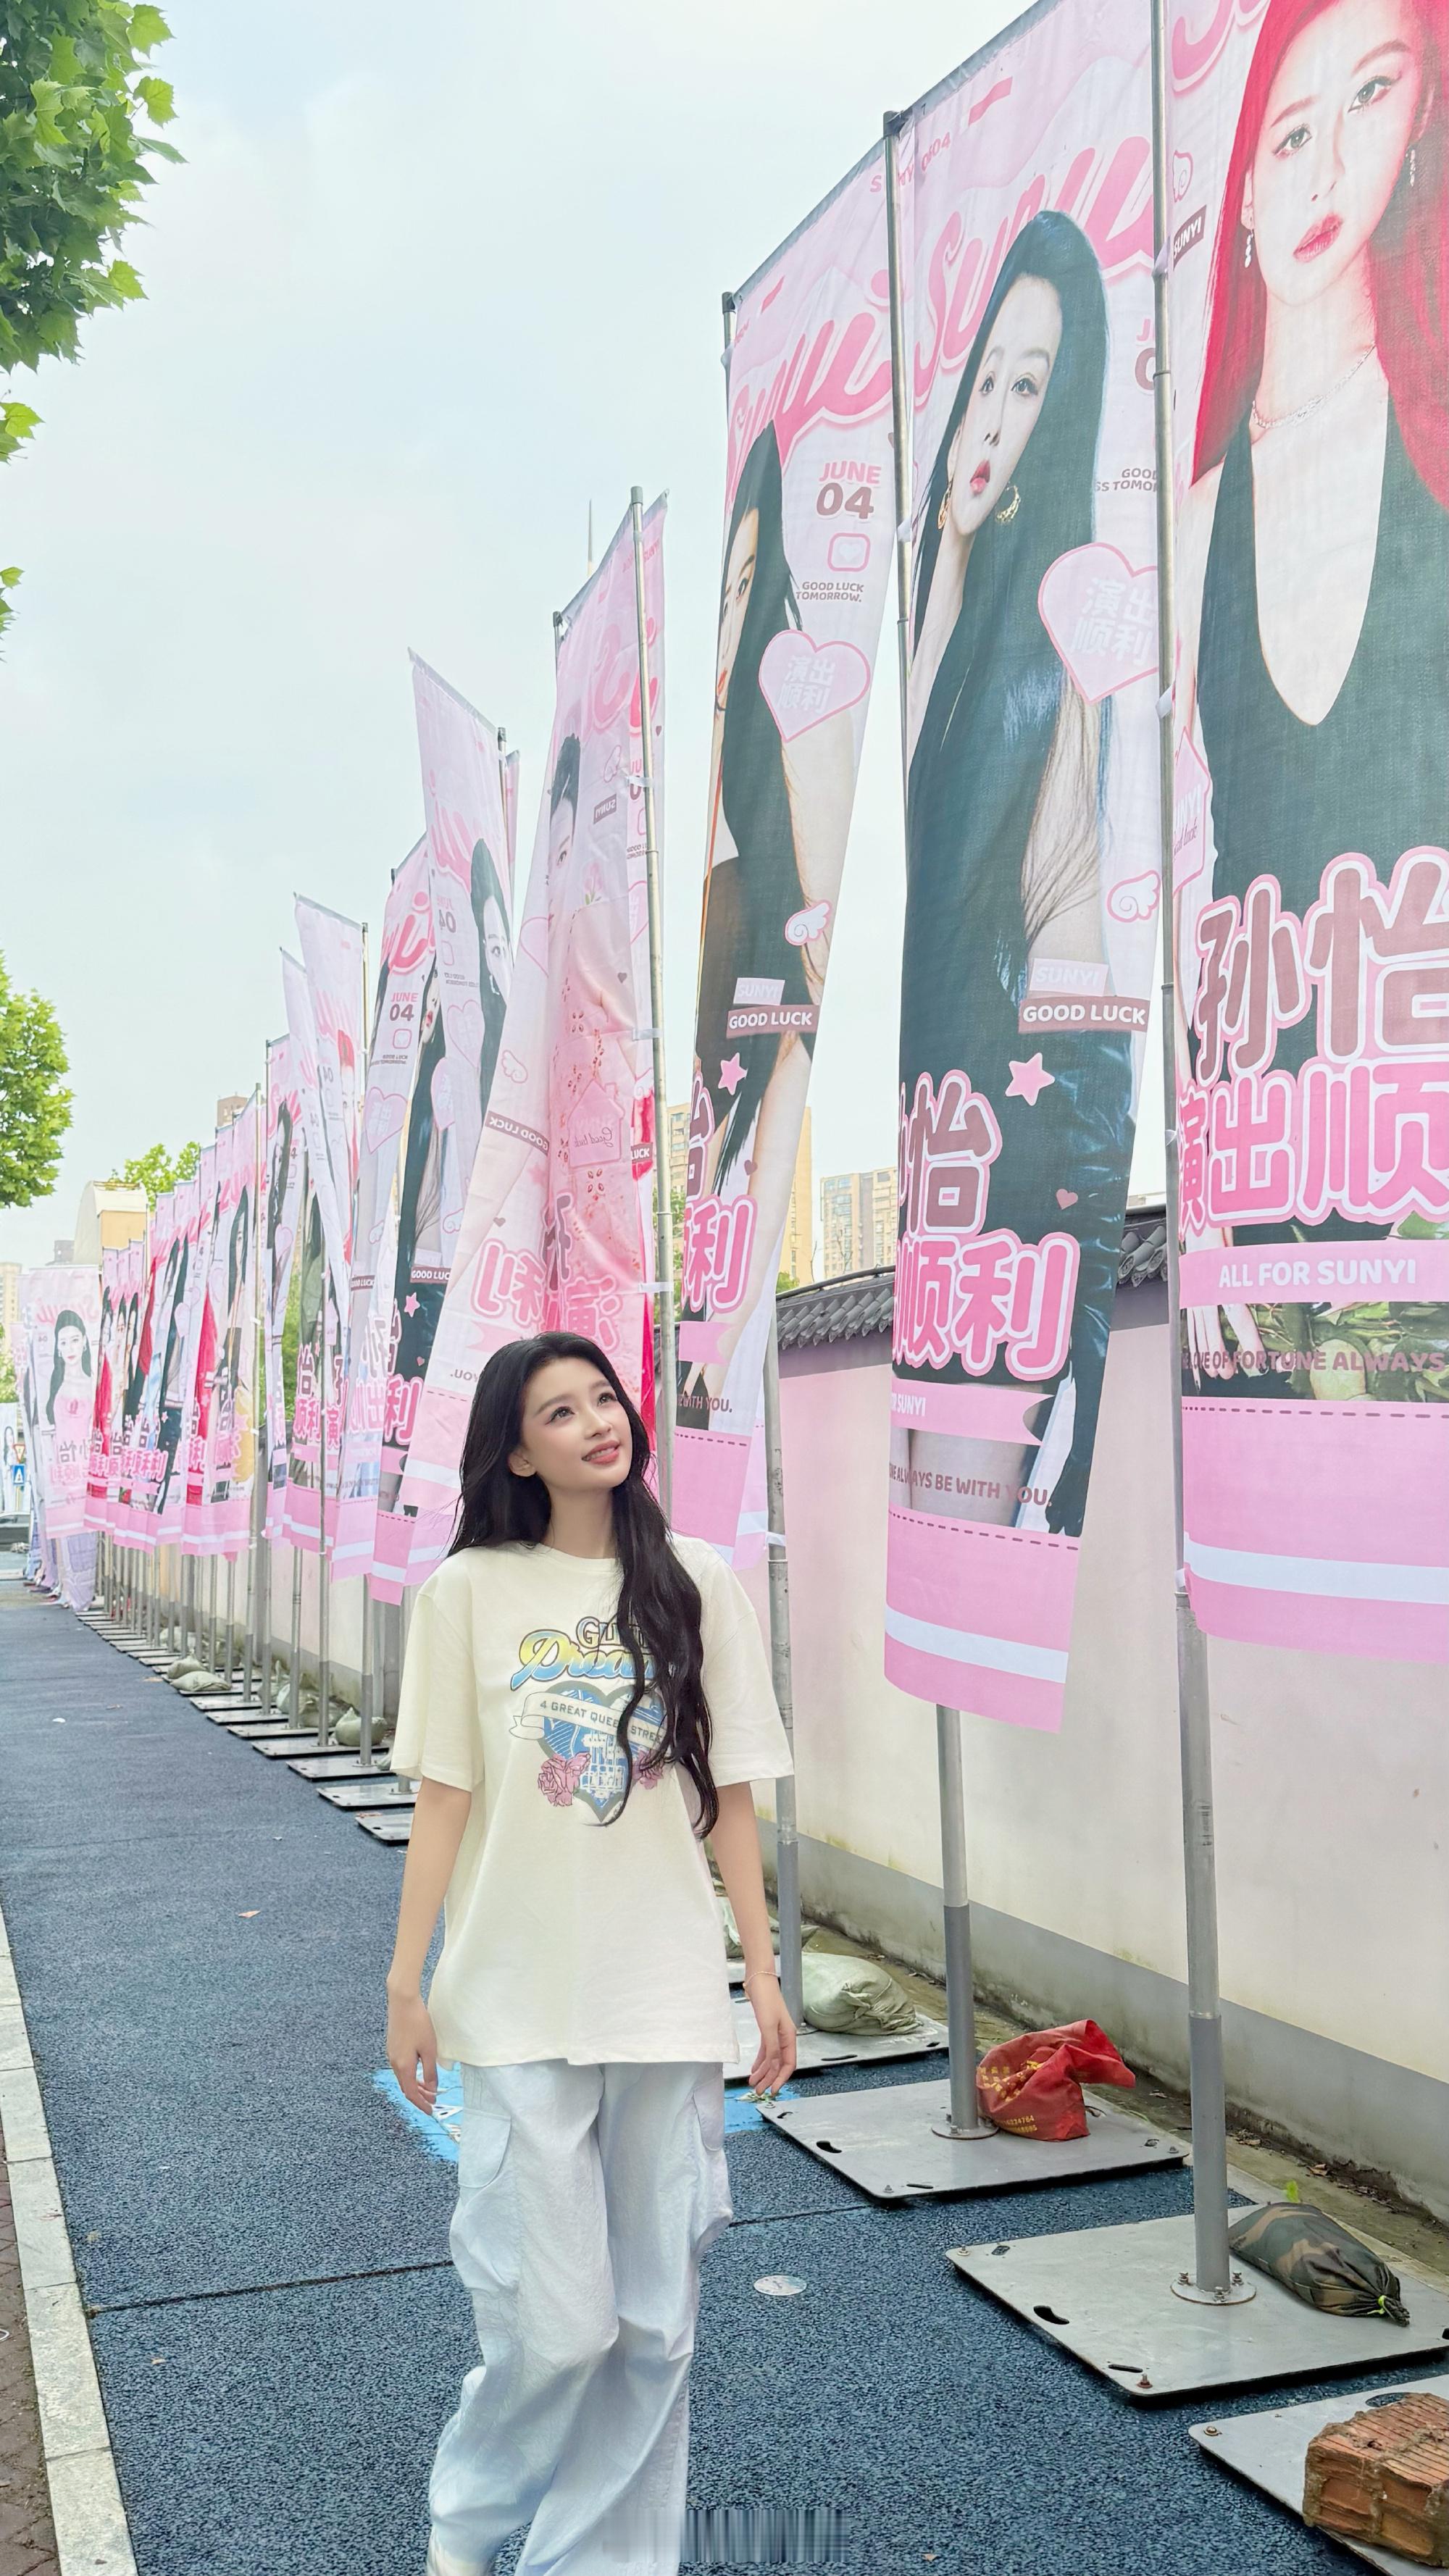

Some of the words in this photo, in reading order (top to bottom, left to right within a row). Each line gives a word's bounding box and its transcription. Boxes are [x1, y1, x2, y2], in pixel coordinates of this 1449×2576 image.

[1173, 217, 1203, 259] SUNYI
[819, 461, 881, 484] JUNE
[1114, 480, 1157, 492] TOMO
[817, 482, 874, 519] 04
[796, 591, 862, 602] TOMORROW.
[802, 582, 834, 591] GOOD
[836, 583, 864, 593] LUCK
[1083, 577, 1156, 628] 演出
[1072, 618, 1154, 665] 顺利
[778, 682, 832, 714] 顺利
[1036, 967, 1101, 986] SUNYI
[391, 993, 418, 1002] JUNE
[737, 984, 780, 999] SUNYI
[390, 1004, 414, 1021] 04
[729, 1013, 768, 1029] GOOD
[770, 1011, 813, 1026] LUCK
[1023, 1005, 1086, 1024] GOOD
[1091, 1005, 1146, 1025] LUCK
[632, 1147, 650, 1159] LUCK
[683, 1203, 750, 1305] 利
[412, 1270, 433, 1279] GOOD
[434, 1271, 451, 1281] LUC
[1218, 1264, 1253, 1288] ALL
[1258, 1261, 1310, 1286] FOR
[1316, 1258, 1416, 1285] SUNYI
[1233, 1350, 1327, 1371] FORTUNE
[1332, 1351, 1445, 1371] ALWAYS
[706, 1396, 732, 1413] YOU.
[896, 1466, 932, 1489] ALWAYS
[935, 1474, 953, 1492] BE
[956, 1477, 1001, 1500] WITH
[1005, 1486, 1051, 1507] YOU.
[551, 1702, 588, 1718] GREAT
[590, 1712, 619, 1728] QUEE
[630, 1724, 662, 1741] STREE
